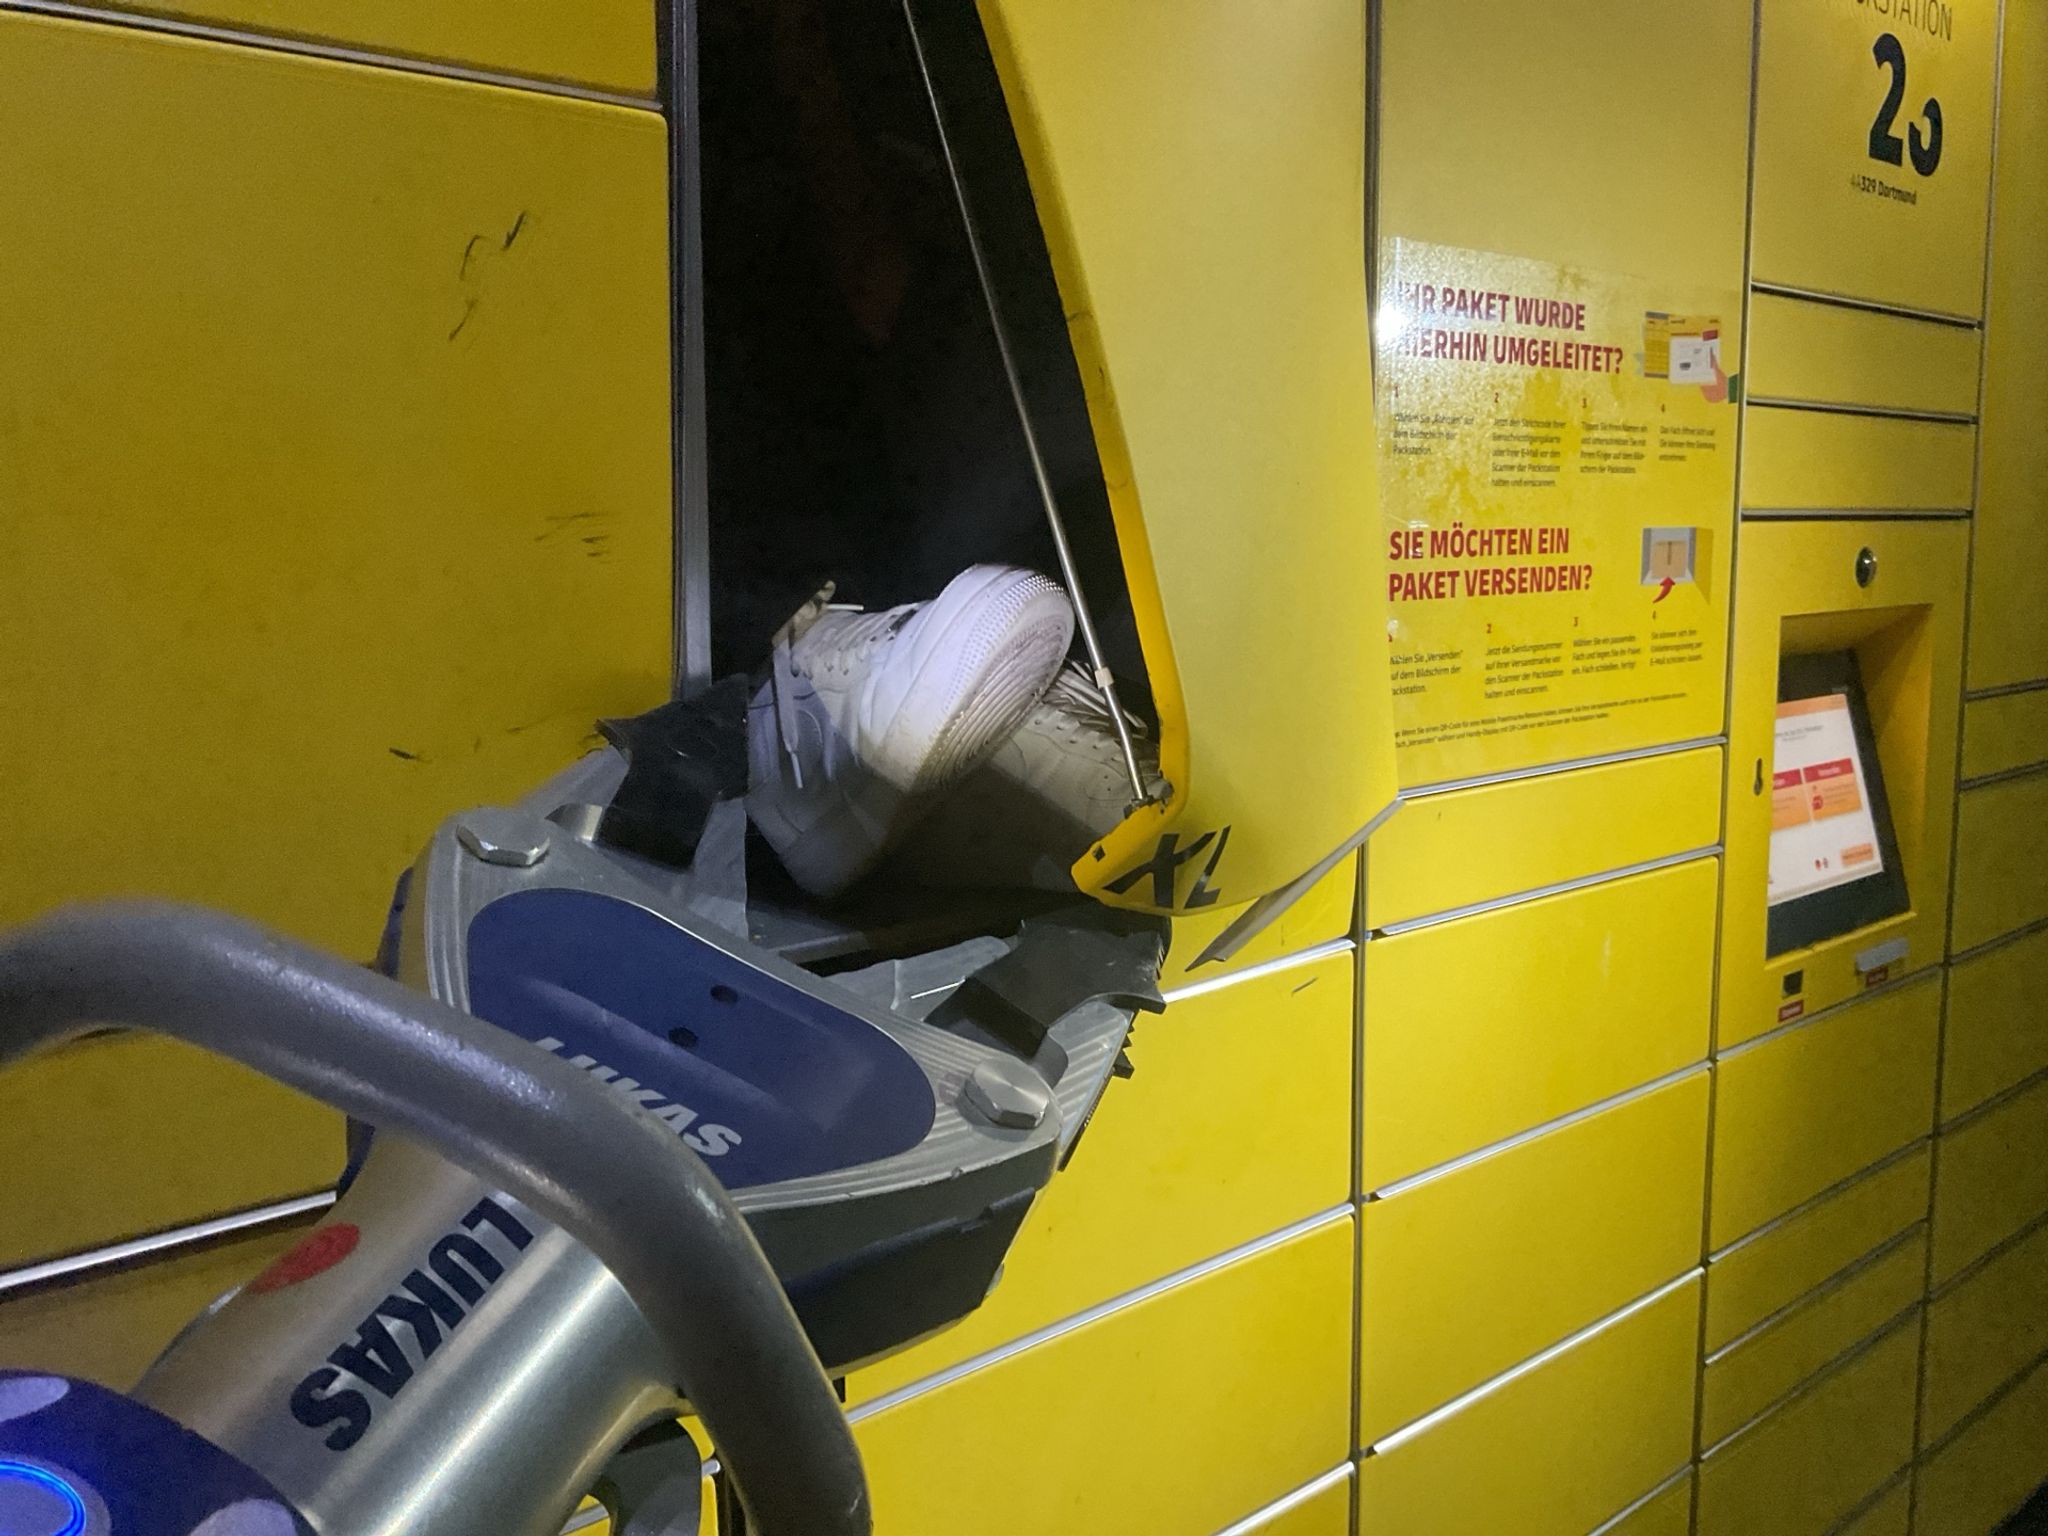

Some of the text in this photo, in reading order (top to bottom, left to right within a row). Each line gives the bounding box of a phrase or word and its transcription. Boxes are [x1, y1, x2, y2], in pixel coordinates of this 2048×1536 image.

[1878, 181, 1917, 205] Dortmund
[1442, 286, 1509, 322] PAKET
[1514, 296, 1586, 331] WURDE
[1493, 335, 1623, 374] UMGELEITET?
[1389, 522, 1570, 560] SIE MÖCHTEN EIN
[1389, 564, 1593, 602] PAKET VERSENDEN?
[1486, 623, 1492, 634] 2
[1573, 616, 1579, 627] 3
[1102, 825, 1231, 910] XL
[290, 1197, 534, 1451] LUKAS
